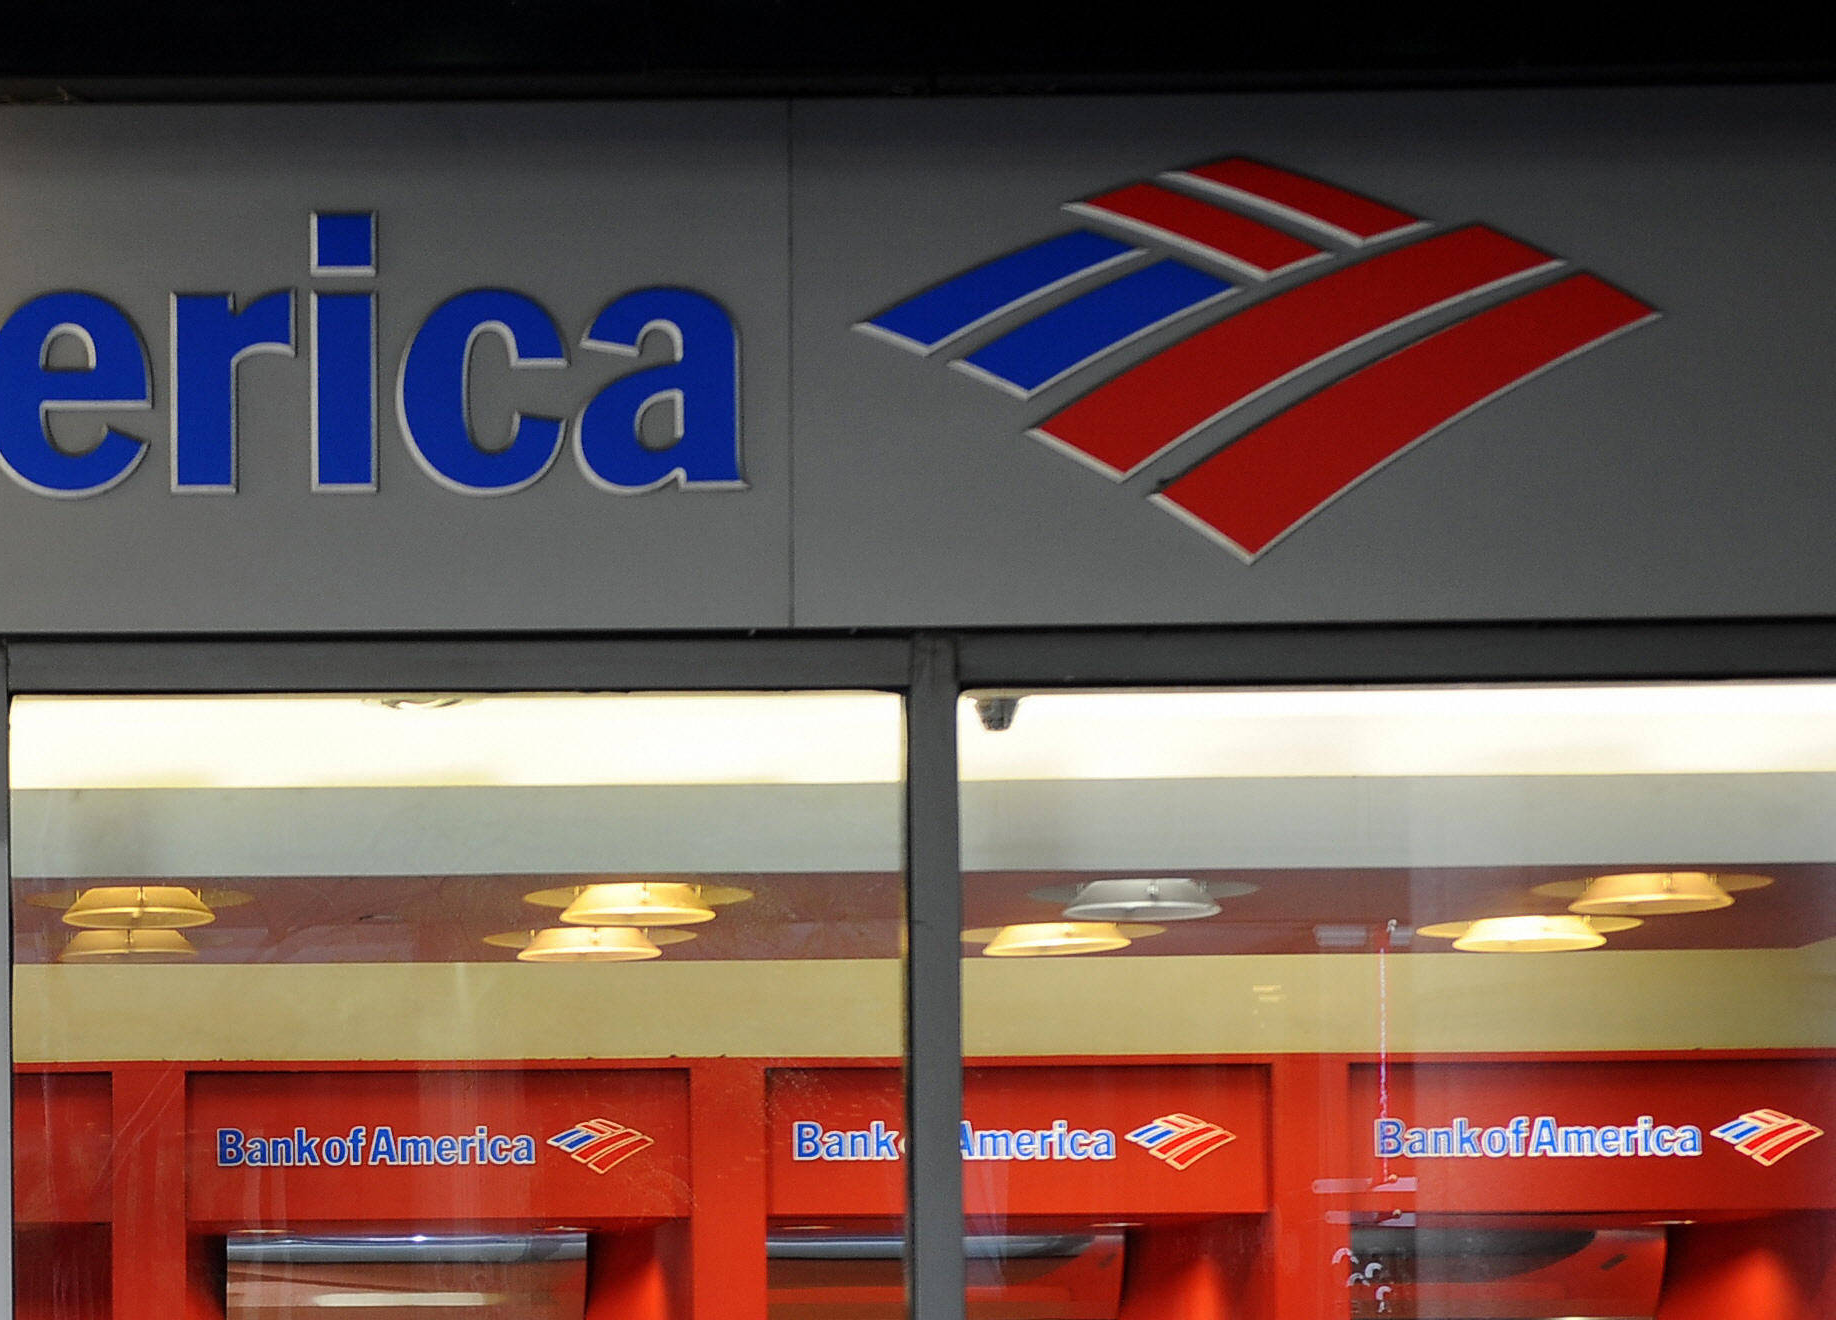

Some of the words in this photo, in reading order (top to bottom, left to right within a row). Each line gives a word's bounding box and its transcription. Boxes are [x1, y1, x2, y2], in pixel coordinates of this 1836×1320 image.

[216, 1127, 321, 1166] Bank
[323, 1126, 366, 1166] of
[368, 1126, 536, 1166] America
[793, 1121, 900, 1161] Bank
[1375, 1117, 1483, 1158] Bank
[1483, 1116, 1529, 1157] of
[1530, 1116, 1703, 1157] America
